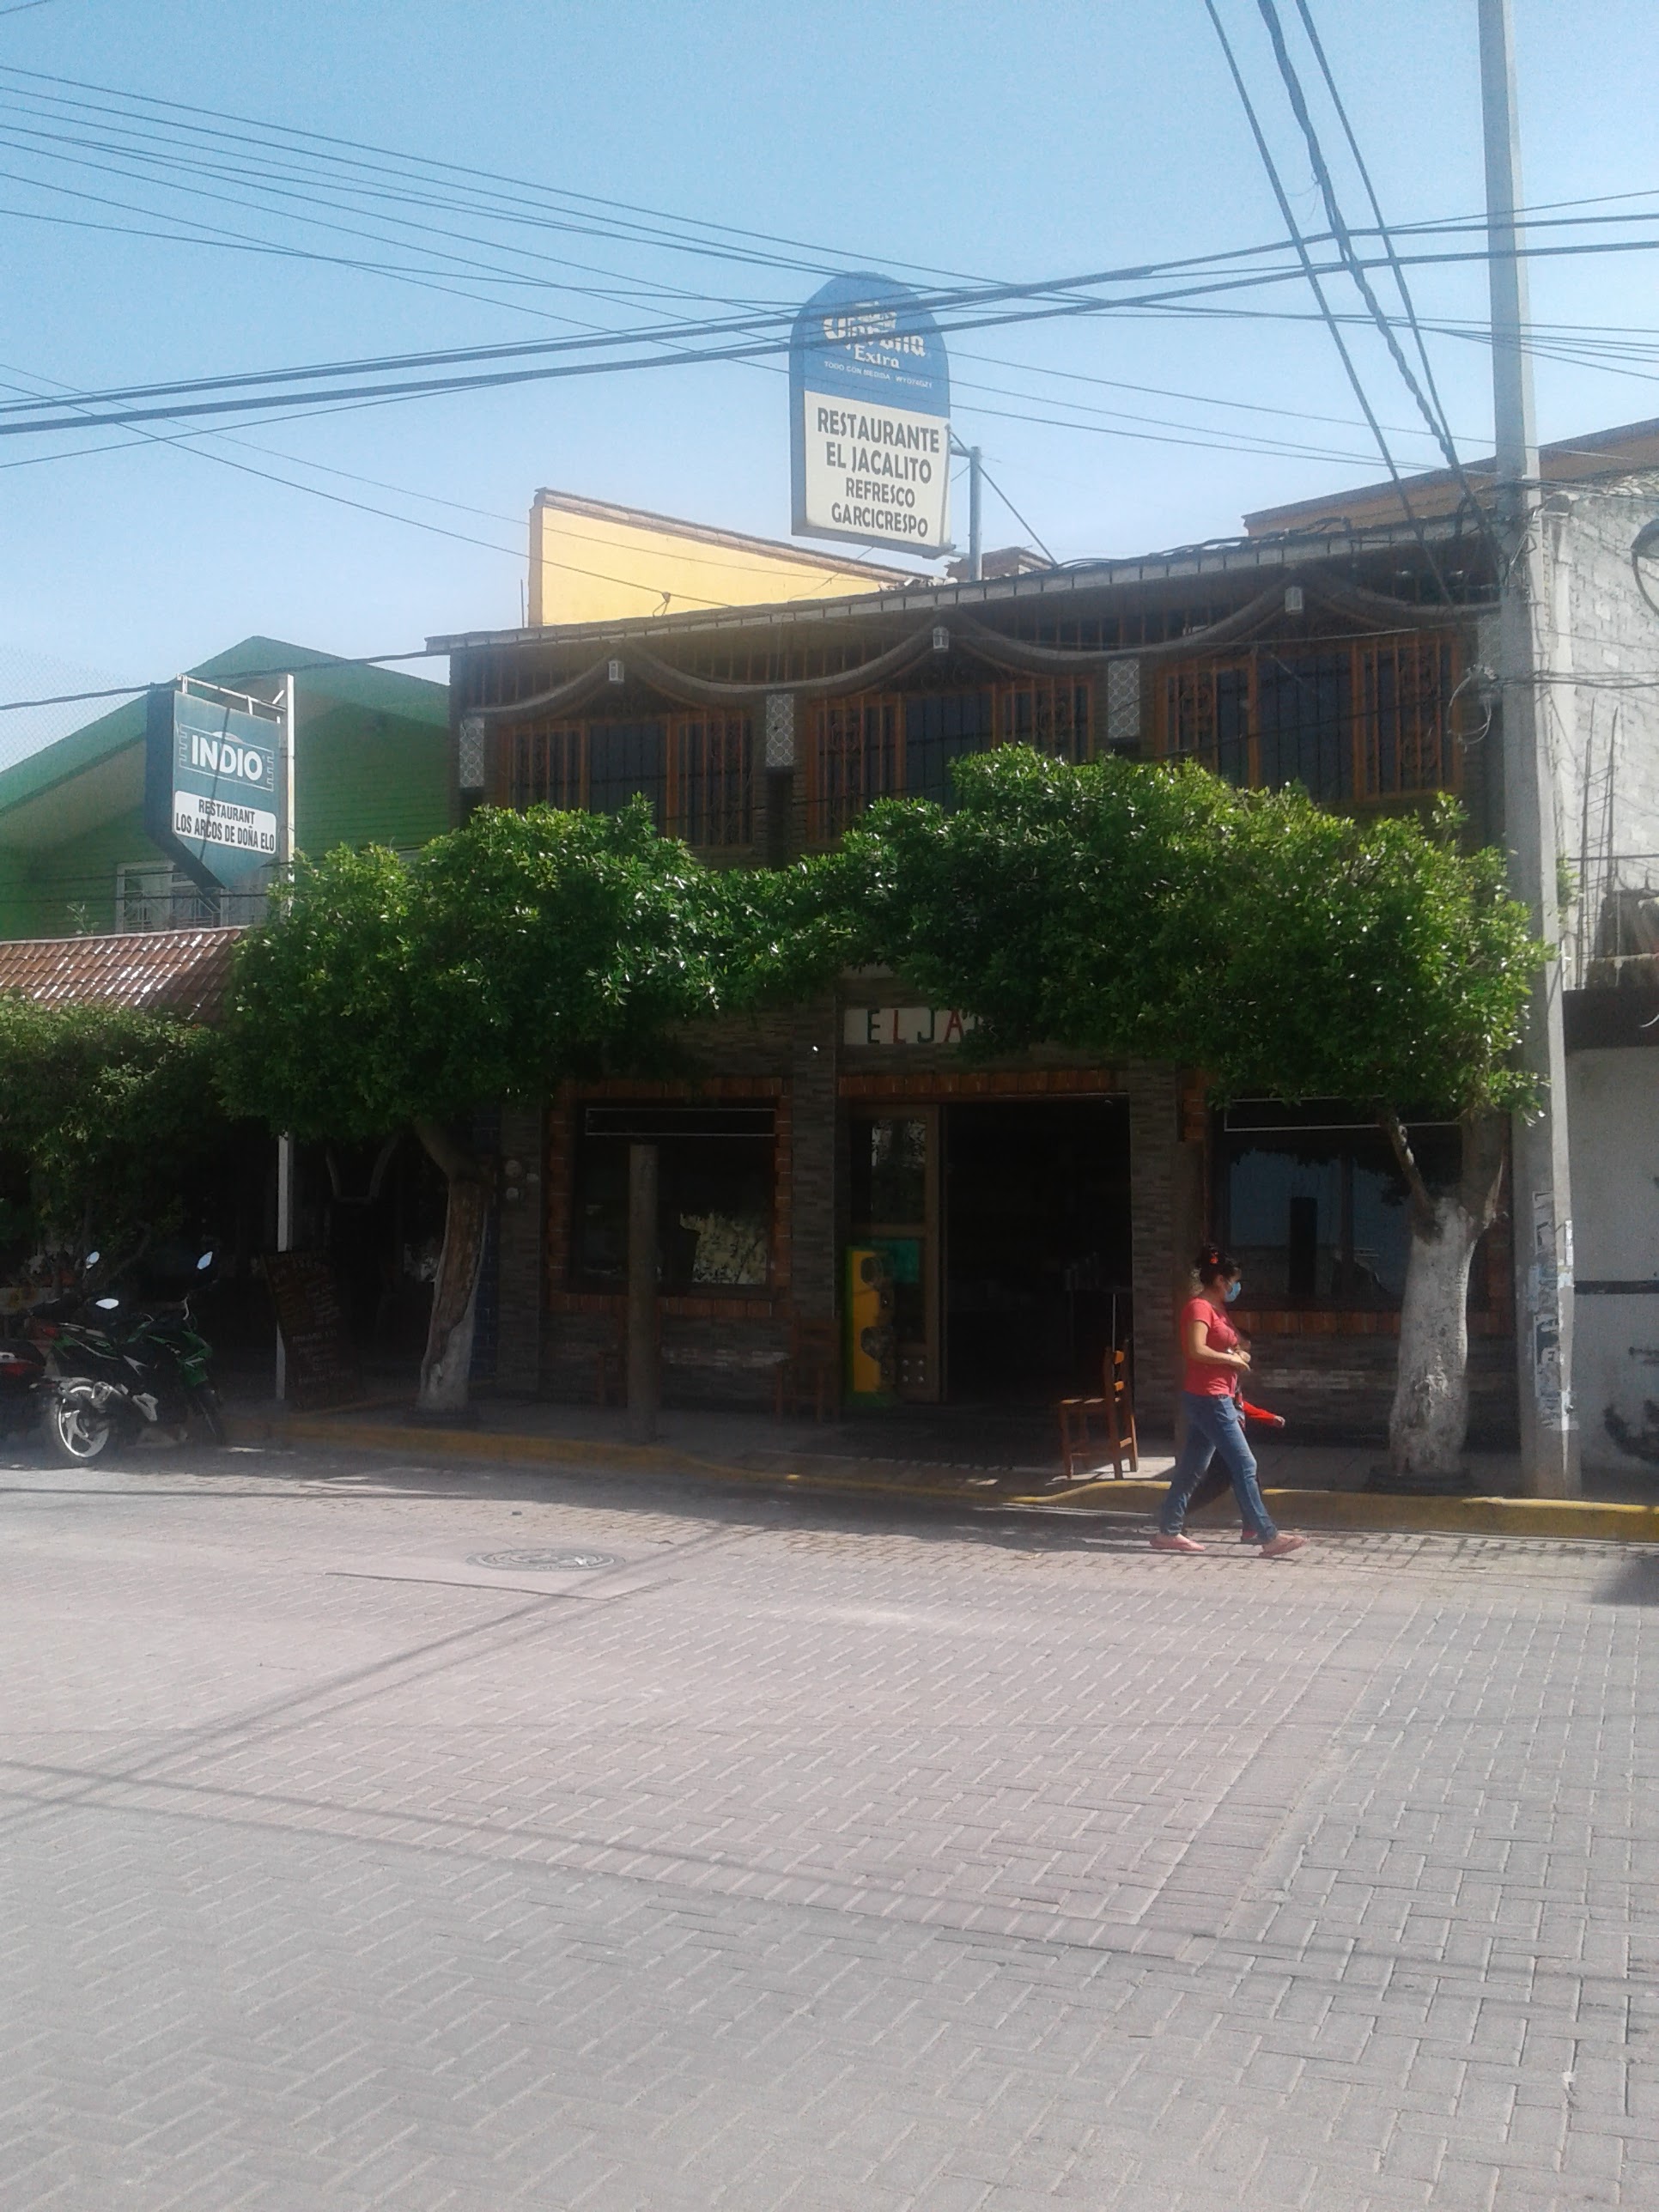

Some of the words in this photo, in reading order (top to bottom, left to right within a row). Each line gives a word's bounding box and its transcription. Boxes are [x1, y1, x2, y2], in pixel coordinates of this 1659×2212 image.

[824, 361, 845, 371] TODO
[846, 365, 862, 375] CON
[863, 368, 891, 380] MEDIDA
[854, 343, 900, 369] Extra
[817, 407, 939, 453] RESTAURANTE
[826, 441, 847, 469] EL
[851, 445, 933, 484] JACALITO
[845, 476, 915, 509] REFRESCO
[830, 501, 929, 538] GARCICRESPO
[191, 734, 263, 781] INDIO
[198, 799, 255, 824] RESTAURANT
[176, 812, 191, 834] LOS
[194, 817, 222, 841] ARCOS
[224, 823, 236, 844] DE
[237, 825, 259, 848] DOÑA
[259, 832, 276, 852] ELO
